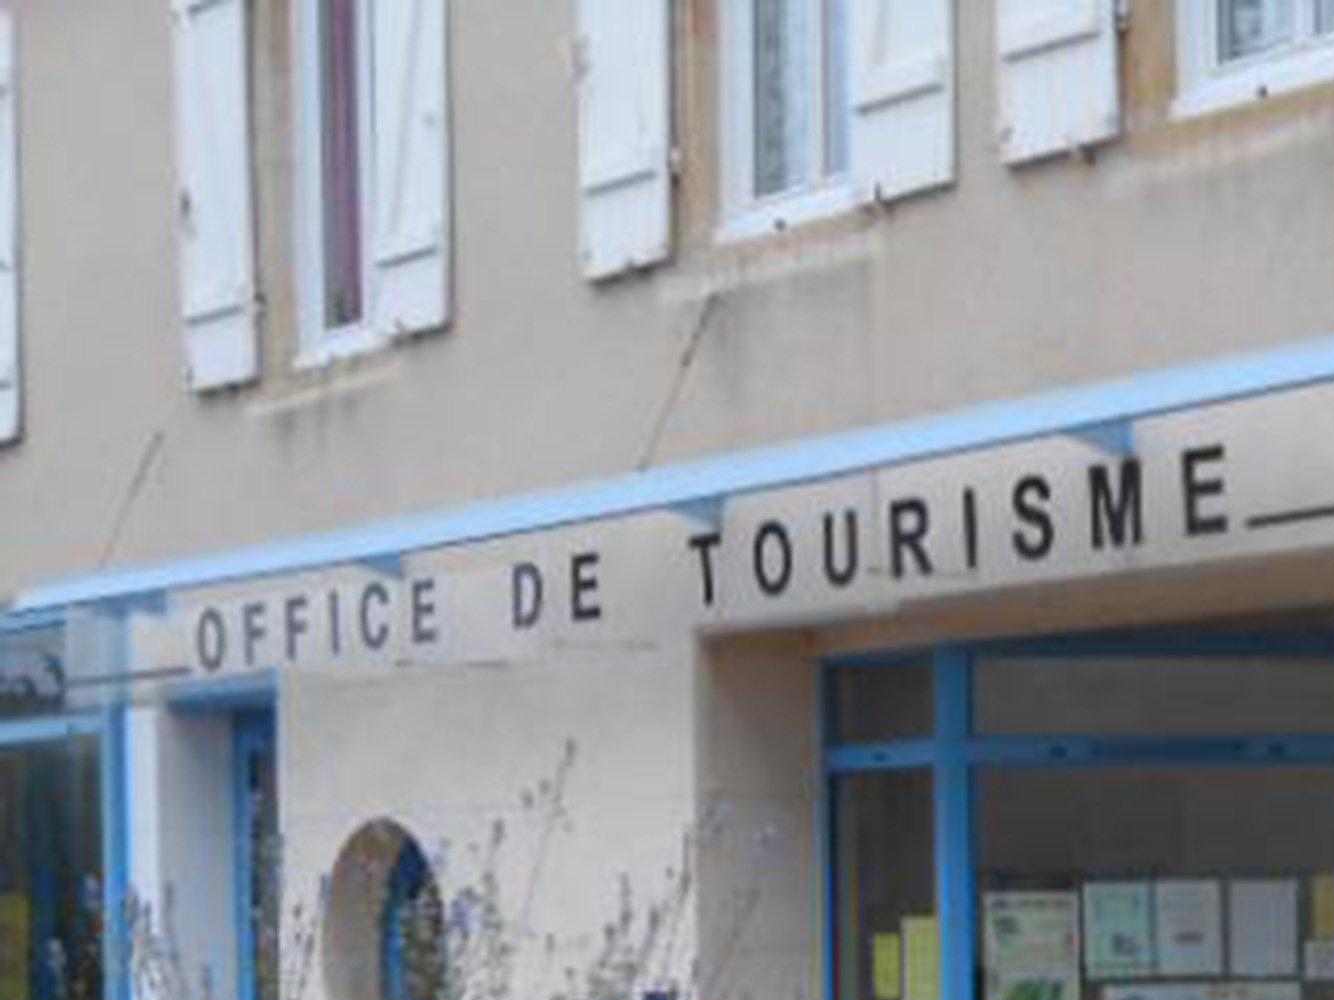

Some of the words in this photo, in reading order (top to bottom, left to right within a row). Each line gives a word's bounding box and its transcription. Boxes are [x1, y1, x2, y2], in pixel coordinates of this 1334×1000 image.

[195, 578, 438, 672] OFFICE
[511, 552, 602, 630] DE
[688, 446, 1229, 607] TOURISME
